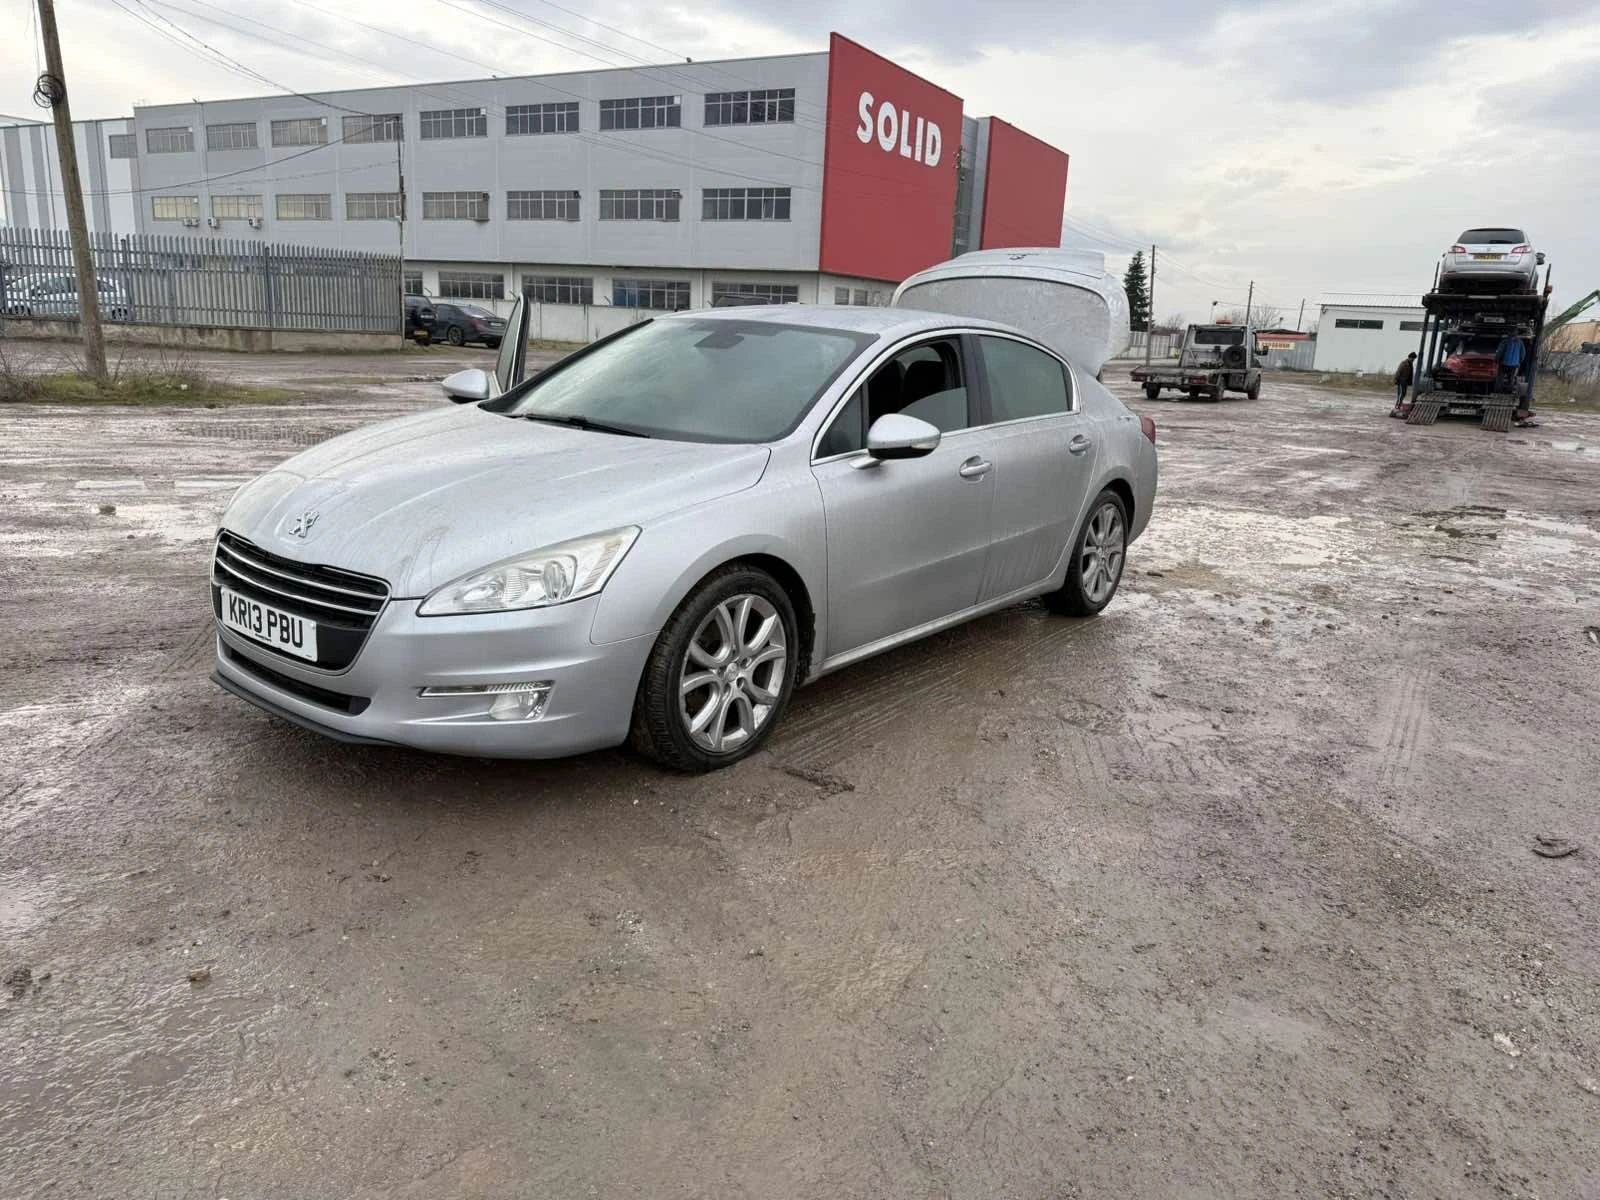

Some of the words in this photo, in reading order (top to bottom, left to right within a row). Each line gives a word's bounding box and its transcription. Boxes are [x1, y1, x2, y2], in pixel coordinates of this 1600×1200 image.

[857, 92, 942, 167] SOLID
[229, 593, 262, 633] KR13
[267, 609, 303, 648] PBU
